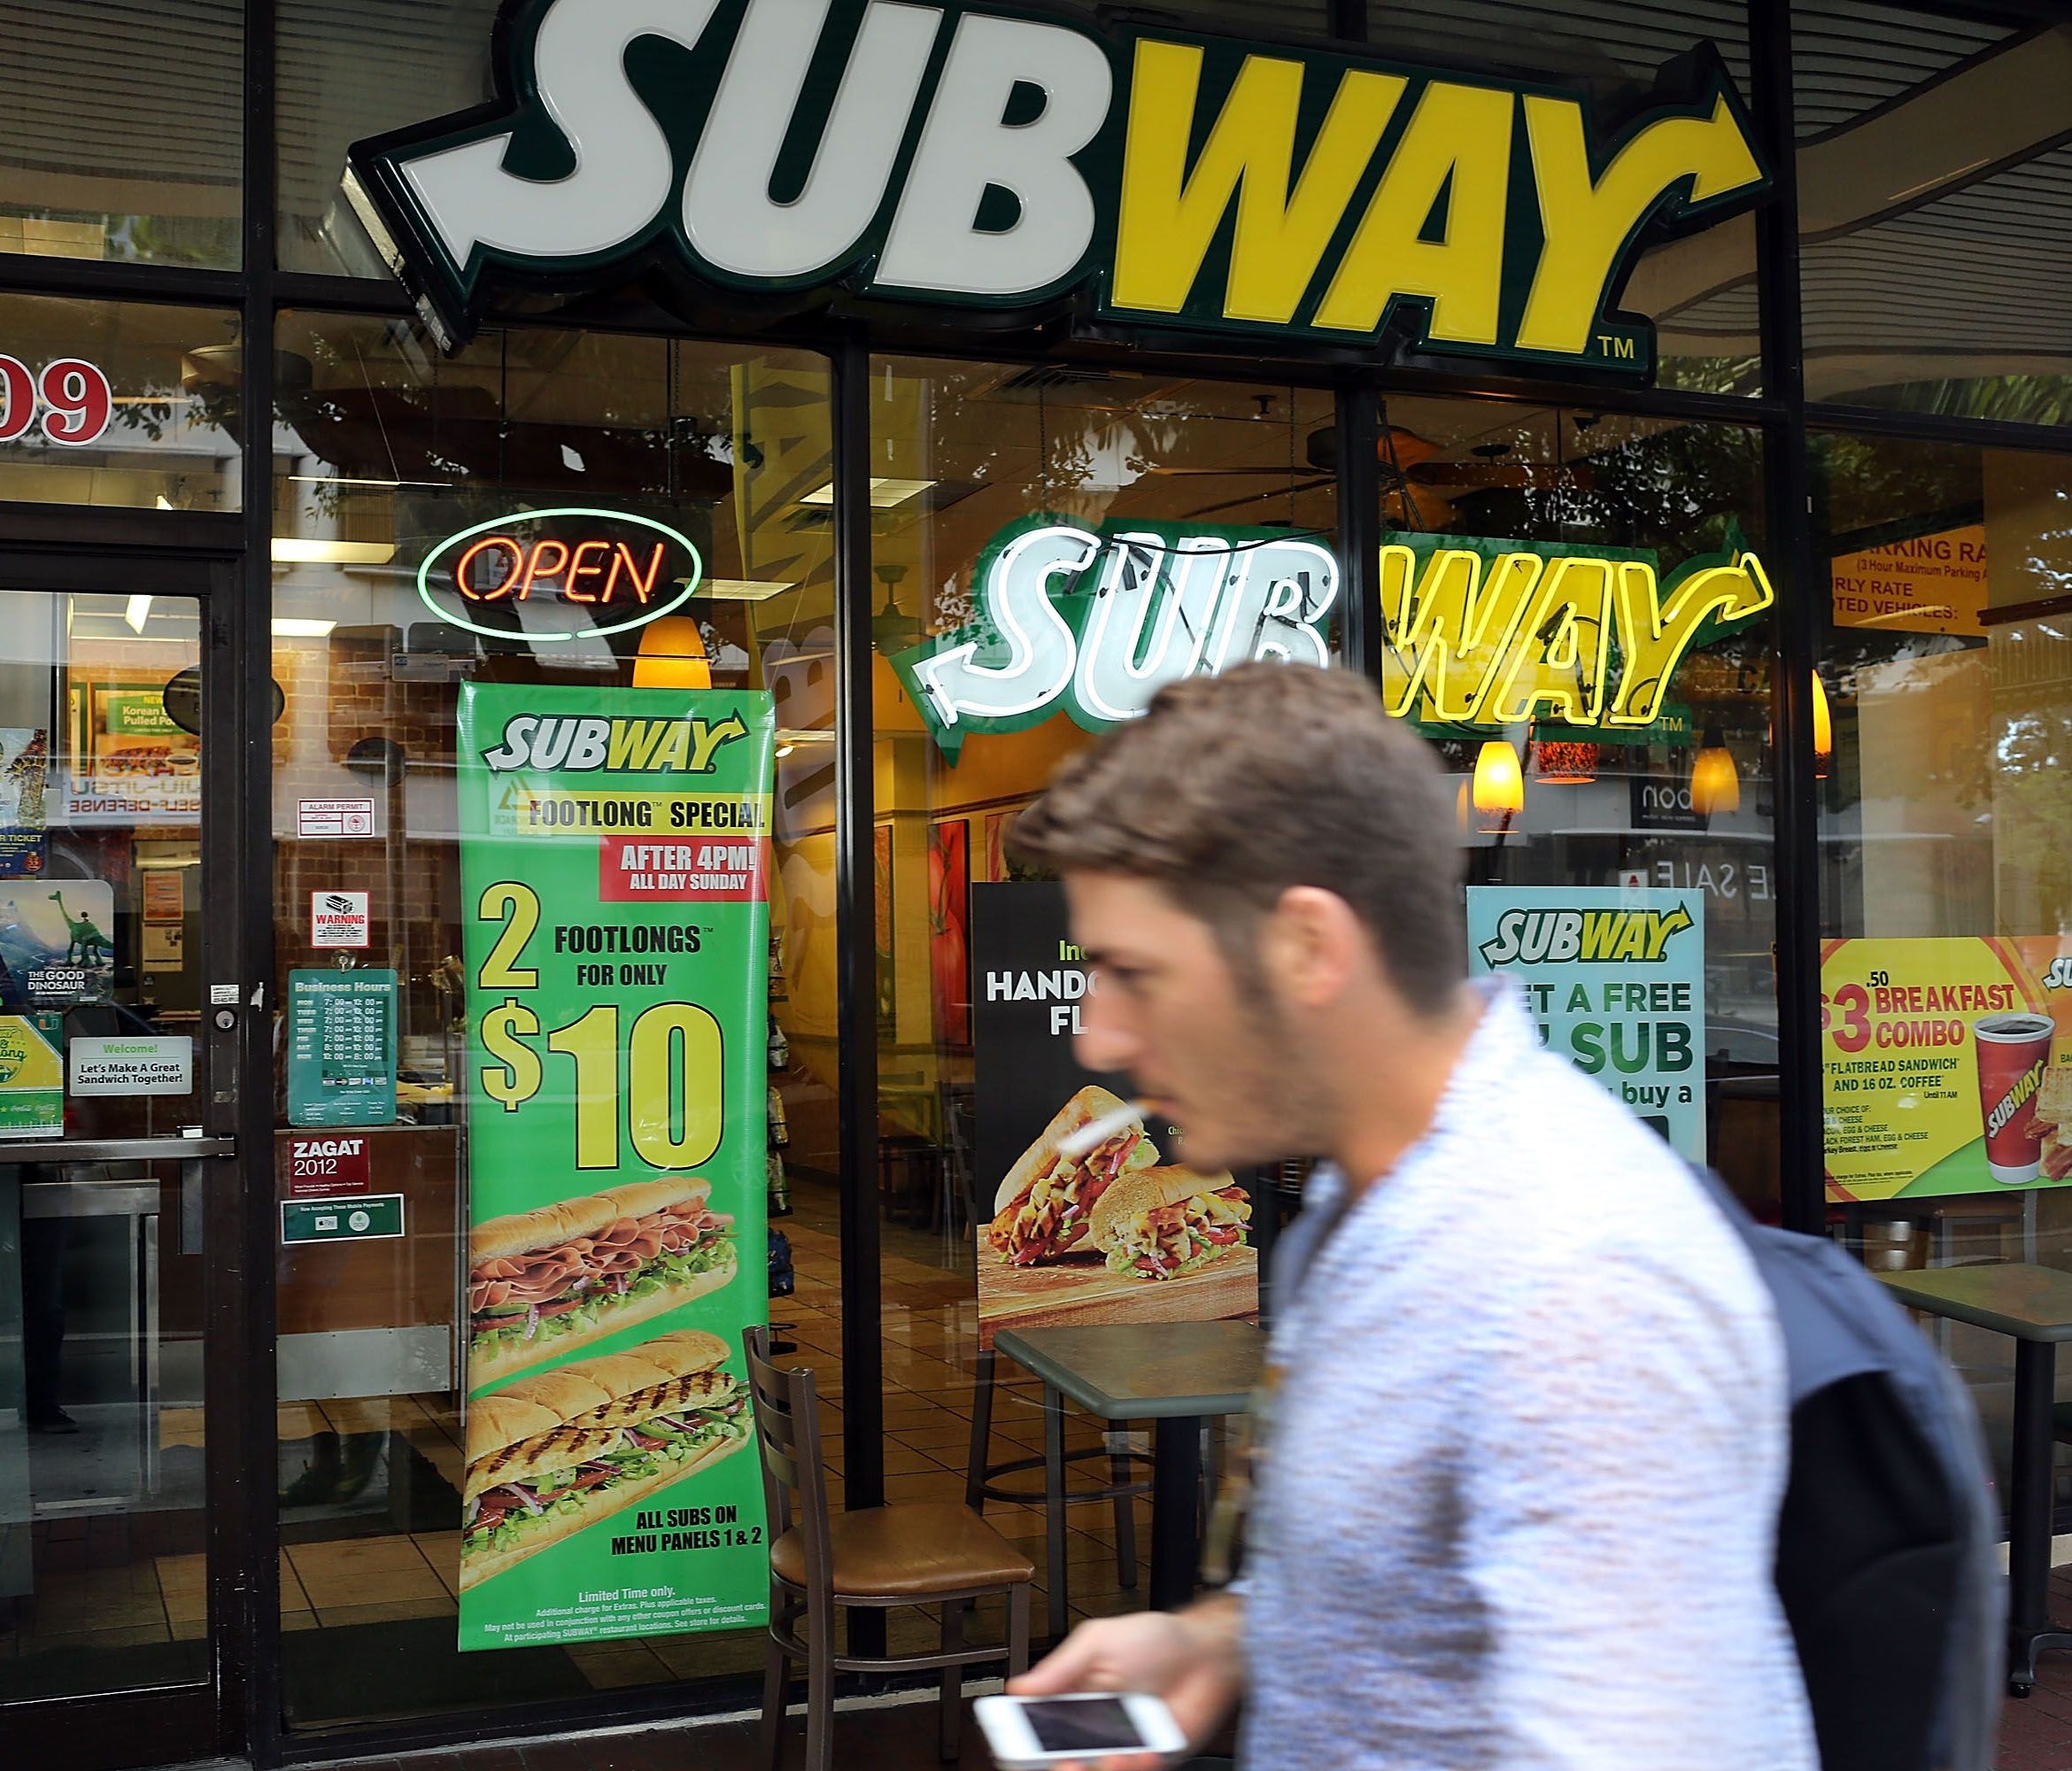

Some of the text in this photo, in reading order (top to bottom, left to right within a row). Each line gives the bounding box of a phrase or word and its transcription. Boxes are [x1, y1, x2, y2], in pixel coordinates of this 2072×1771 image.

[400, 0, 1762, 353] SUBWAY
[457, 536, 665, 603] OPEN
[1871, 581, 1914, 597] RATE
[1830, 596, 1868, 613] TED
[123, 705, 159, 715] Korean
[124, 715, 157, 725] Pulled
[483, 711, 750, 771] SUBWAY
[670, 800, 765, 828] SPECIAL
[620, 844, 756, 871] AFTER 4PM!
[630, 874, 747, 890] ALL DAY SUNDAY
[316, 914, 365, 924] WARNING
[478, 880, 541, 990] 2
[1481, 905, 1692, 968] SUBWAY
[45, 971, 85, 980] GOOD
[577, 963, 667, 986] FOR ONLY
[27, 981, 85, 990] DINOSAUR
[295, 981, 391, 993] Business Hours
[1566, 983, 1592, 1013] A
[1604, 983, 1691, 1013] FREE
[1875, 984, 2014, 1015] BREAKFAST
[1876, 1019, 1965, 1048] COMBO
[103, 1044, 158, 1054] Welcome!
[1573, 1022, 1693, 1075] SUB
[81, 1063, 180, 1073] Let's Make A Great
[1898, 1058, 1958, 1071] SANDWICH
[78, 1073, 182, 1086] Sandwich Together!
[480, 997, 724, 1172] $10
[1833, 1075, 1942, 1092] AND 16 OZ. COFFEE
[1621, 1081, 1670, 1109] buy
[1678, 1086, 1691, 1103] a
[1987, 1060, 2044, 1139] SUBWAY
[293, 1140, 364, 1158] ZAGAT
[1840, 1135, 1864, 1144] FOREST
[294, 1158, 337, 1176] 2012
[637, 1505, 737, 1530] ALL SUBS ON
[611, 1527, 762, 1556] MENU PANELS 1 & 2
[579, 1585, 676, 1603] Limited Time only.
[536, 1607, 574, 1617] Additional
[575, 1605, 600, 1616] charge
[657, 1597, 694, 1609] applicable
[484, 1623, 501, 1633] May
[527, 1620, 545, 1629] used
[599, 1614, 616, 1623] with
[617, 1614, 630, 1623] any
[632, 1612, 652, 1620] other
[653, 1610, 680, 1620] coupon
[681, 1607, 702, 1617] offers
[713, 1604, 744, 1613] discount
[514, 1630, 561, 1643] participating
[599, 1623, 638, 1634] restaurant
